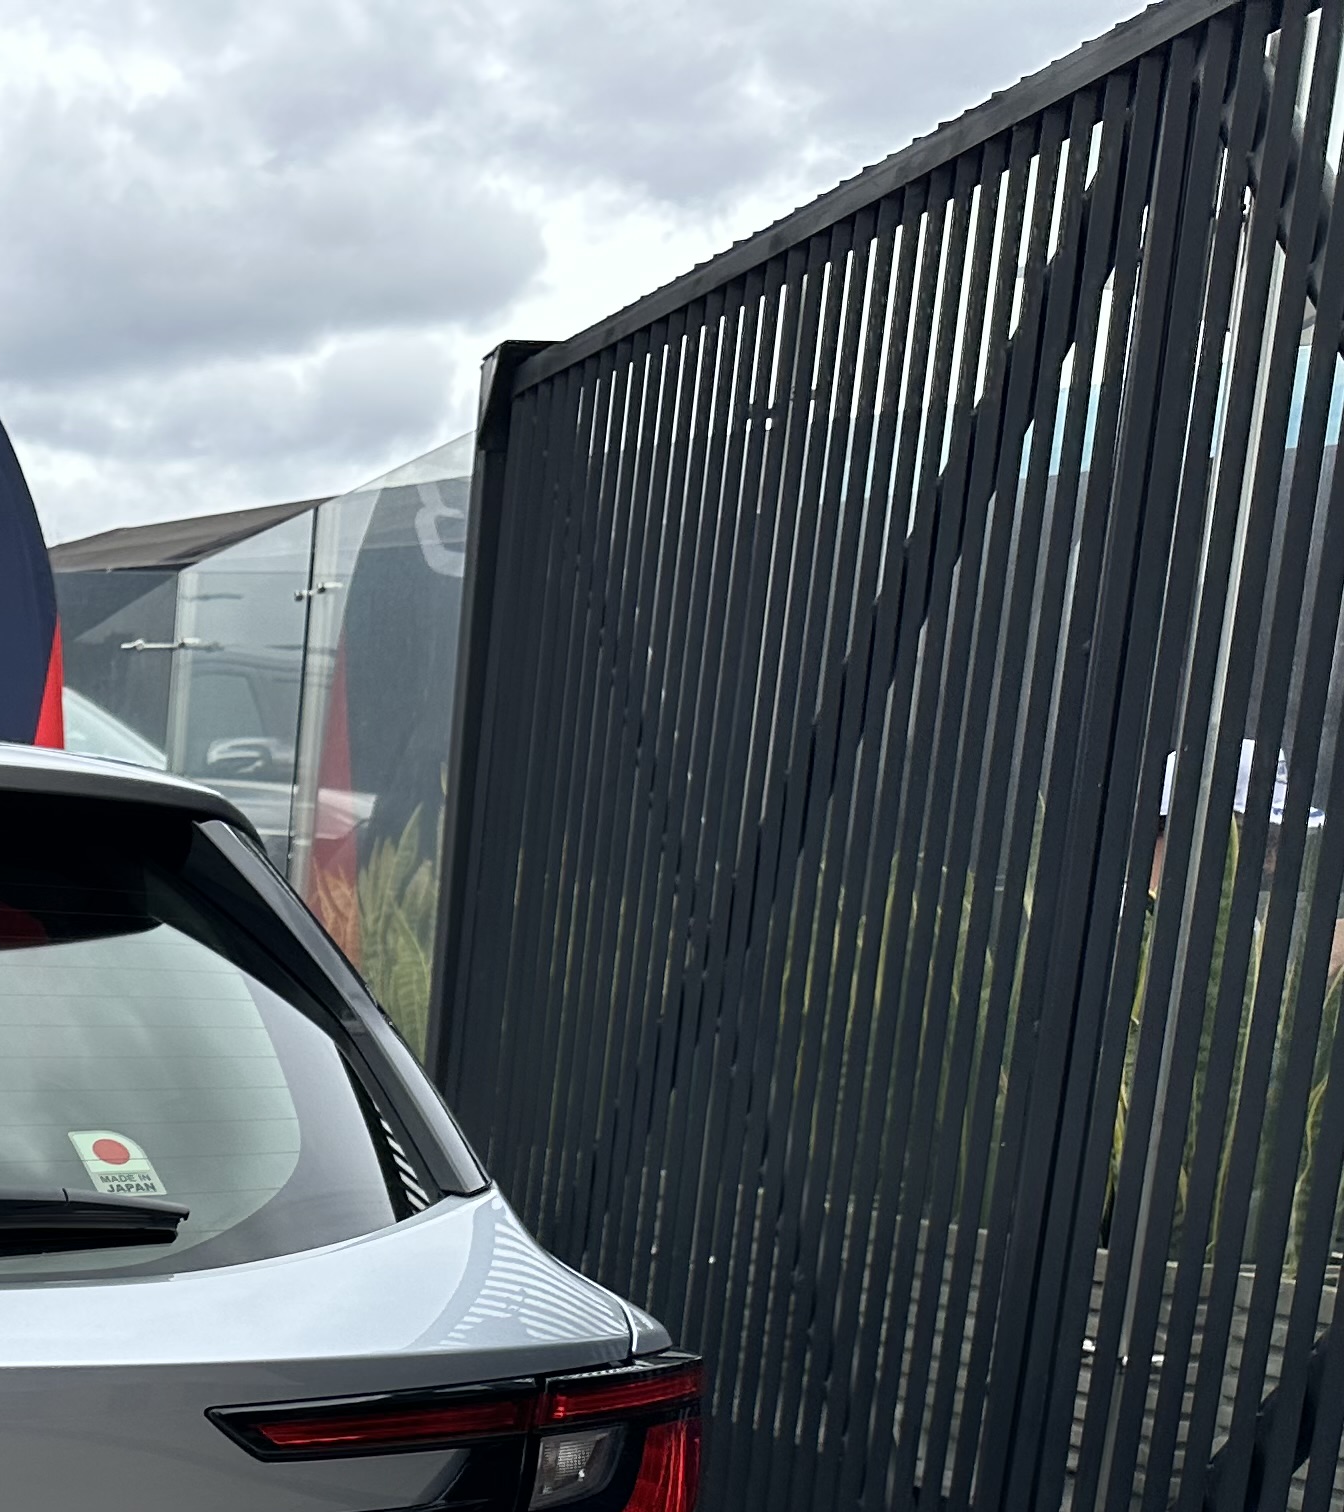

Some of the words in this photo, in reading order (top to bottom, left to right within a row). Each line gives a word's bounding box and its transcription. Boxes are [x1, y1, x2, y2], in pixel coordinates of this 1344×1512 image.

[100, 1173, 134, 1183] MADE
[138, 1173, 151, 1182] IN
[107, 1183, 157, 1193] JAPAN
